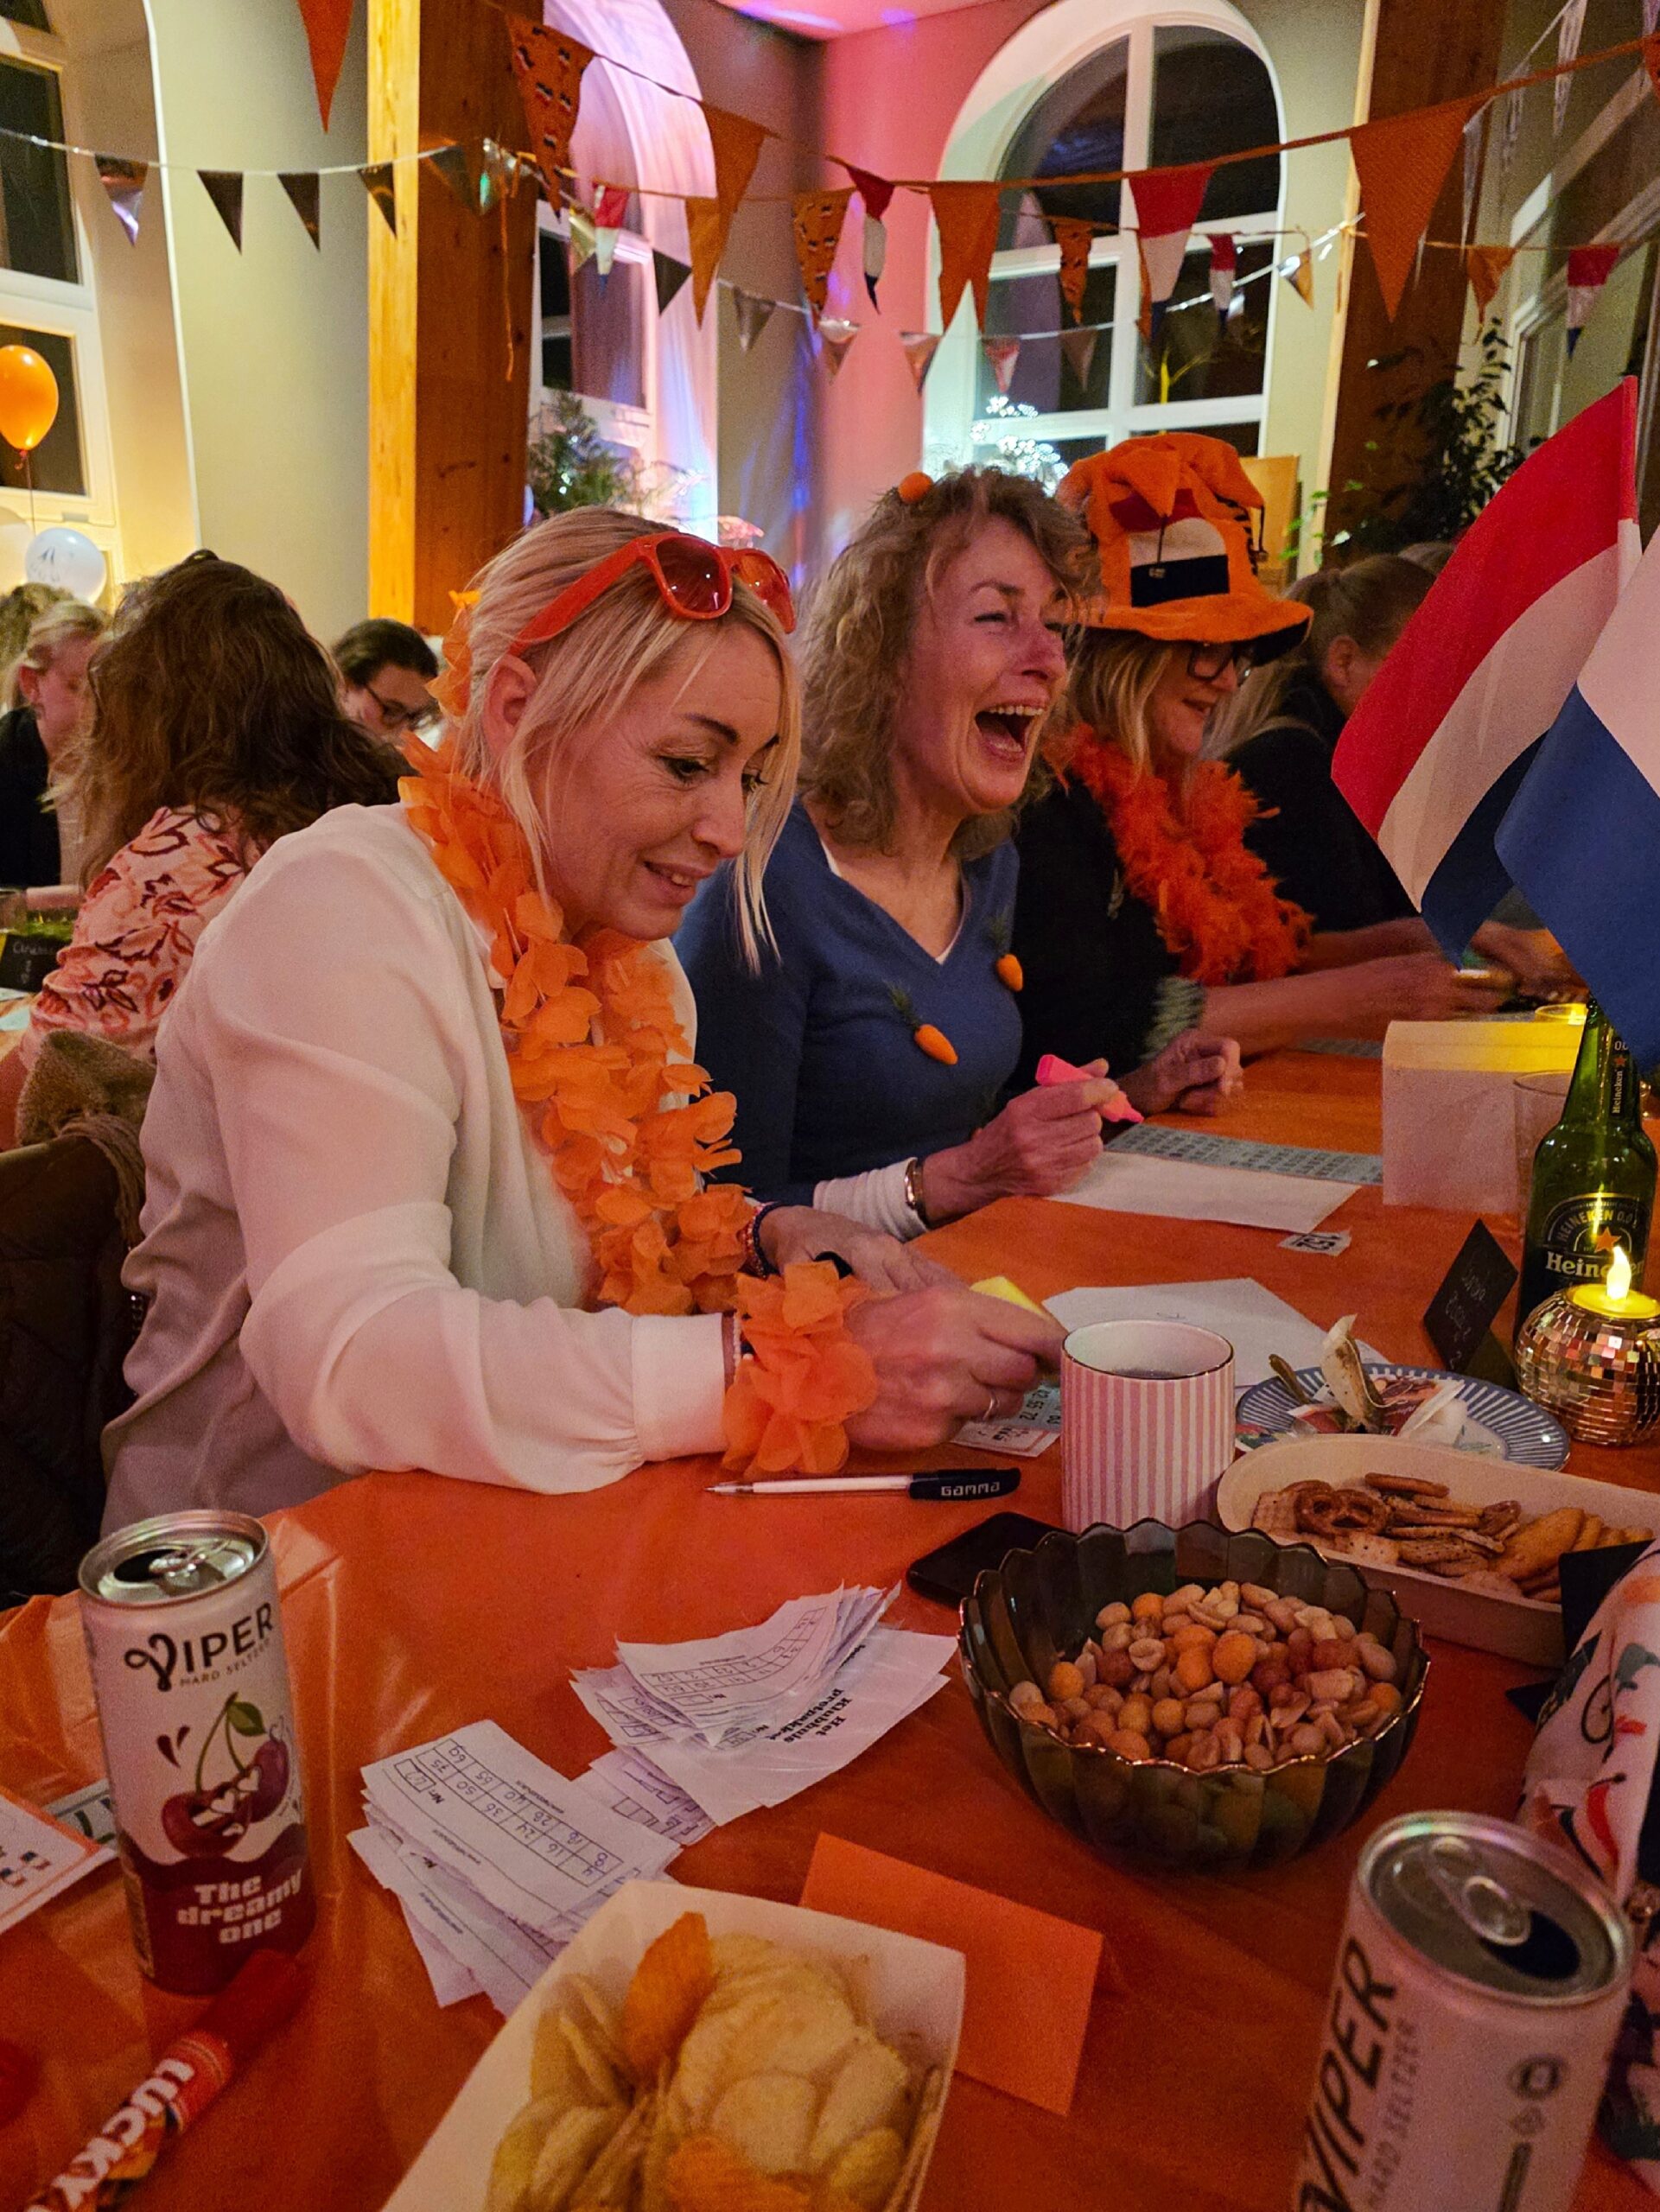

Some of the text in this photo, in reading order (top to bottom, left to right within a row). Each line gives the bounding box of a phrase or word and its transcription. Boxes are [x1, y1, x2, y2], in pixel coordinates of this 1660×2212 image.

[1611, 1071, 1623, 1114] Heineken
[124, 1602, 273, 1693] VIPER
[180, 1669, 220, 1685] HARD
[815, 1716, 847, 1737] Het
[430, 1758, 451, 1774] 75
[455, 1780, 478, 1796] 50
[475, 1770, 494, 1787] 65
[485, 1802, 505, 1818] 36
[516, 1821, 537, 1840] 24
[546, 1842, 563, 1859] 16
[177, 1868, 302, 1925] dreamy
[194, 1875, 262, 1905] The
[219, 1909, 282, 1944] one
[51, 2057, 195, 2212] LUCKY
